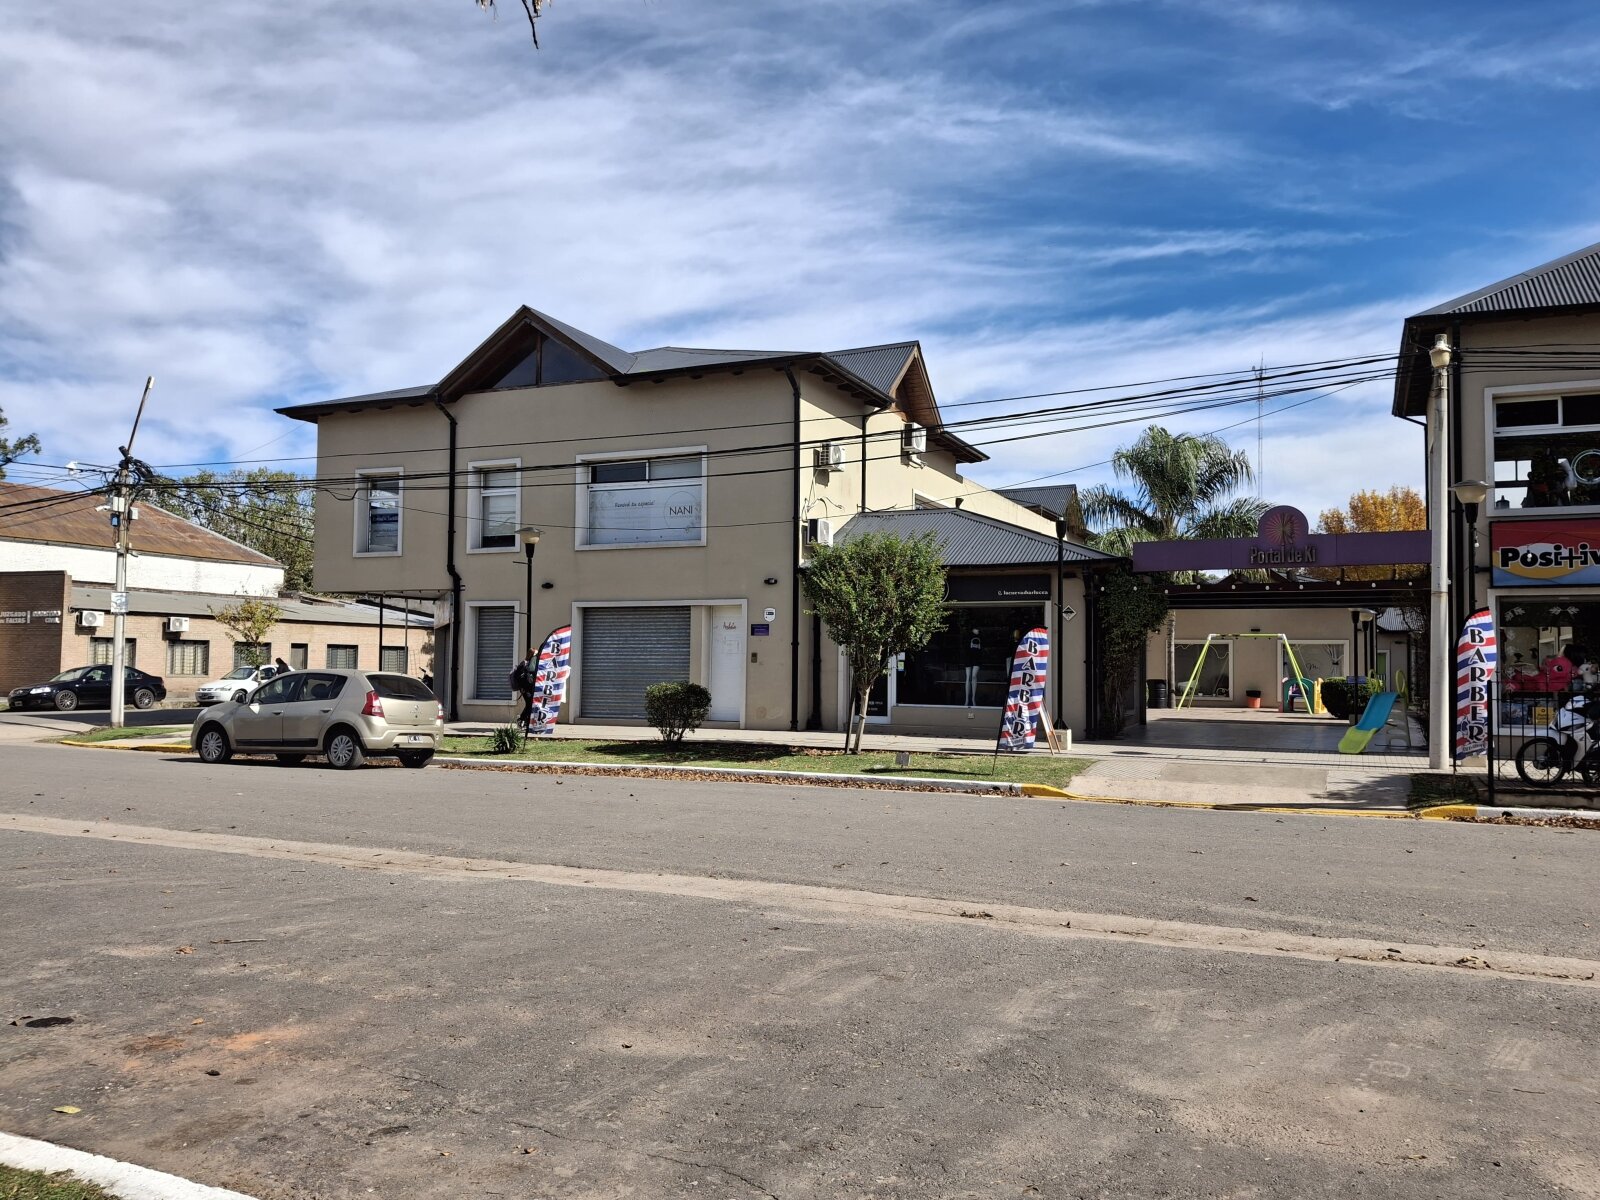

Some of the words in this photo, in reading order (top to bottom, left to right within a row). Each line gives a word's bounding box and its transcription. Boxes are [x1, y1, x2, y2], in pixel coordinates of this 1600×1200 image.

[669, 505, 693, 515] NANI
[1249, 545, 1285, 564] Portal
[1288, 547, 1303, 563] de
[1304, 545, 1316, 562] Ki
[1012, 640, 1038, 737] BARBER
[1468, 628, 1487, 741] BARBER
